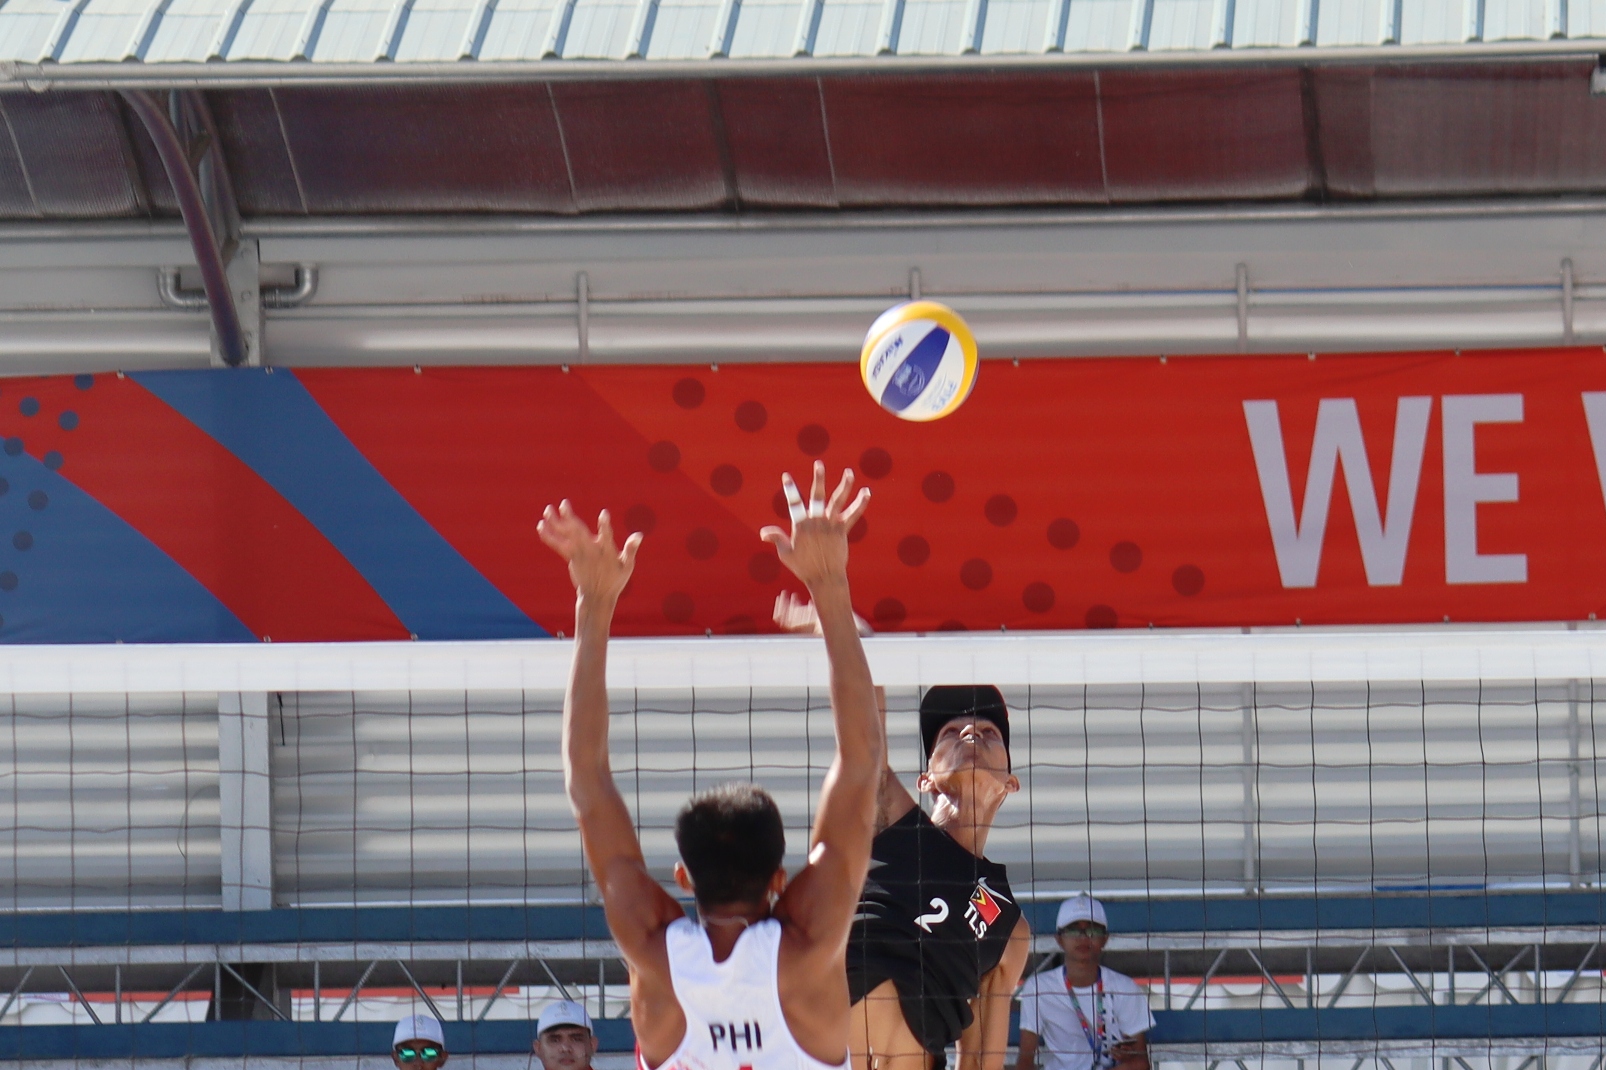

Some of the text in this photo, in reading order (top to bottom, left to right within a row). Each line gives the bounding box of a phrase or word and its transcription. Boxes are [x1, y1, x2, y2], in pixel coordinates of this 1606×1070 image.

[1242, 392, 1529, 588] WE
[914, 897, 950, 933] 2
[963, 901, 988, 940] TLS
[709, 1020, 763, 1053] PHI
